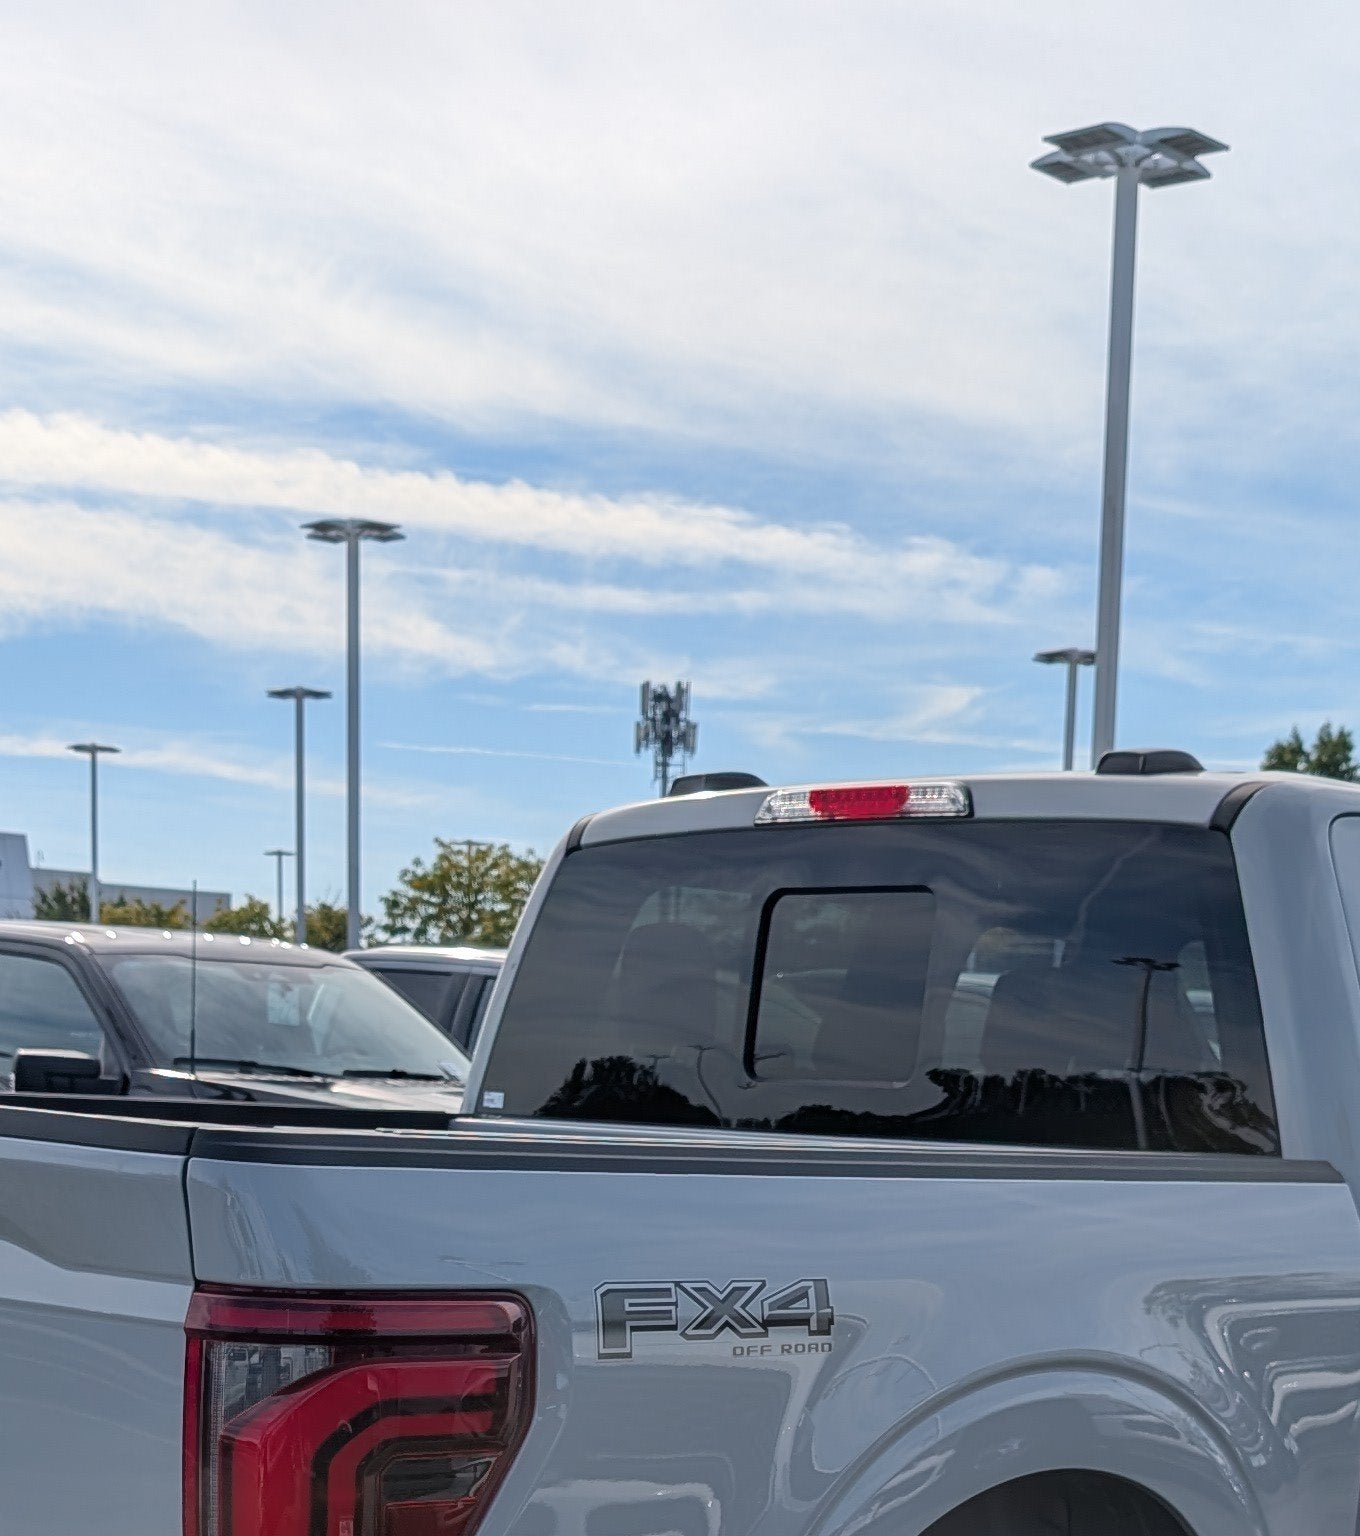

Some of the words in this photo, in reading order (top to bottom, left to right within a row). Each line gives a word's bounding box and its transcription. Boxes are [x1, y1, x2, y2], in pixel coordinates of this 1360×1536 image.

[593, 1278, 835, 1361] FX4
[732, 1345, 772, 1358] OFF
[780, 1342, 832, 1355] ROAD
